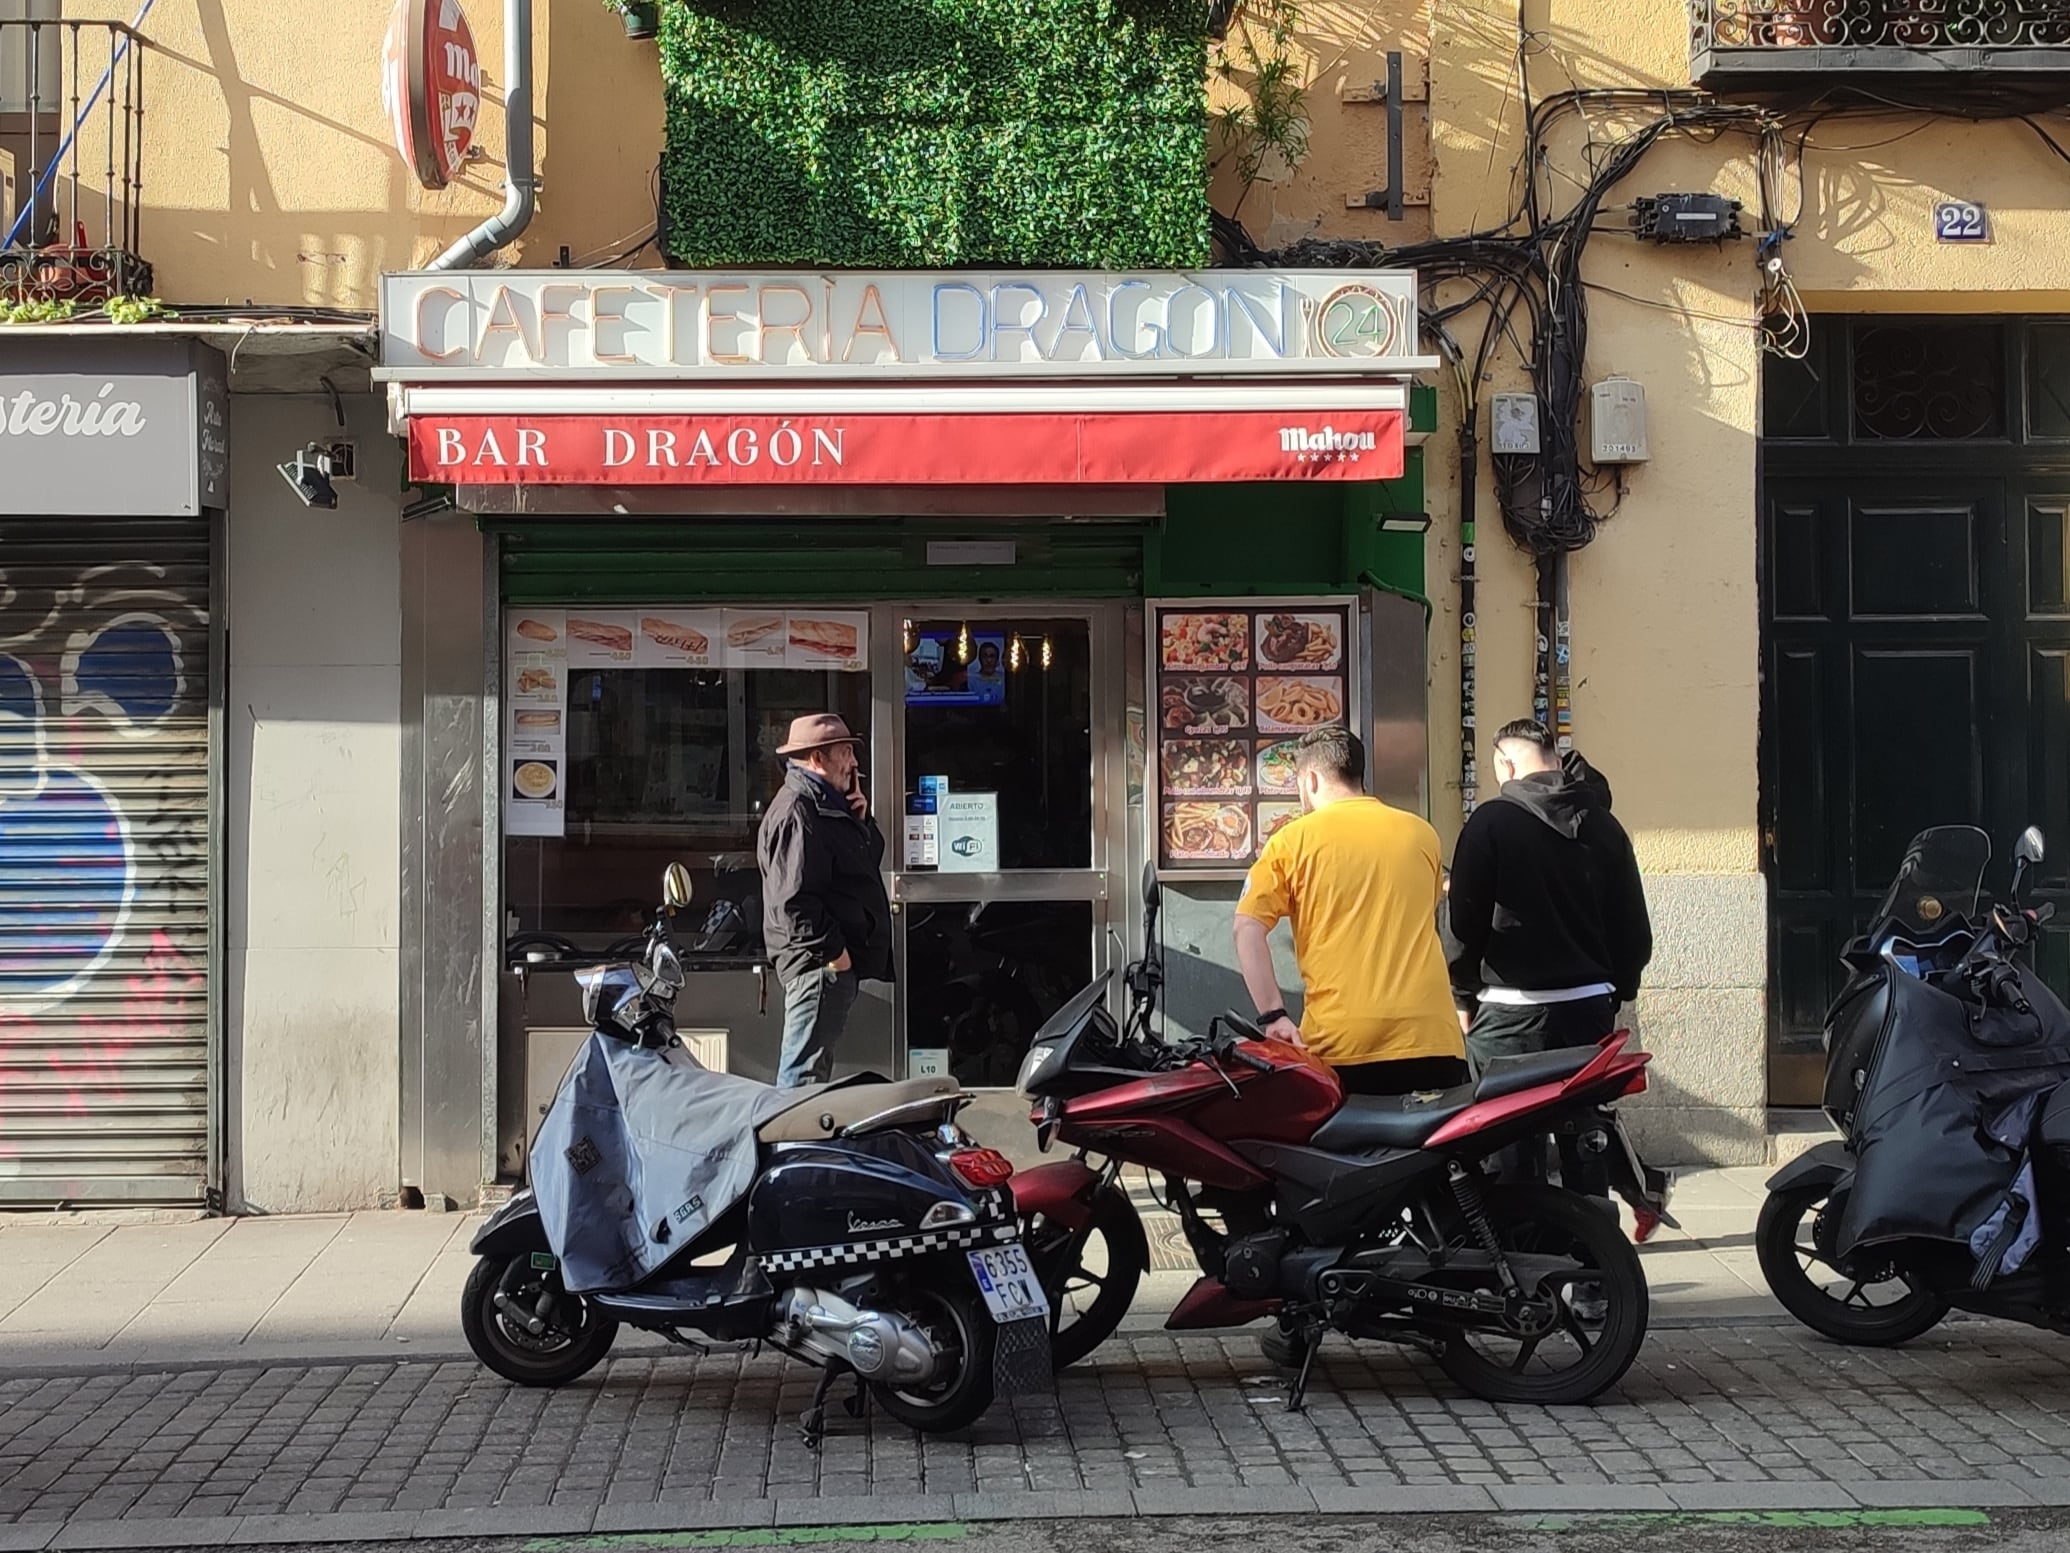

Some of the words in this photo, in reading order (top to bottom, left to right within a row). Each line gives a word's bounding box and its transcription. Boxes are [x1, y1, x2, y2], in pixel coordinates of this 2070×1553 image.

[1941, 206, 1981, 236] 22
[1328, 302, 1385, 346] 24
[436, 427, 549, 467] BAR
[602, 419, 847, 467] DRAGÓN
[1278, 425, 1377, 452] Mahou
[950, 801, 984, 810] ABIERTO
[984, 1248, 1028, 1278] 6355
